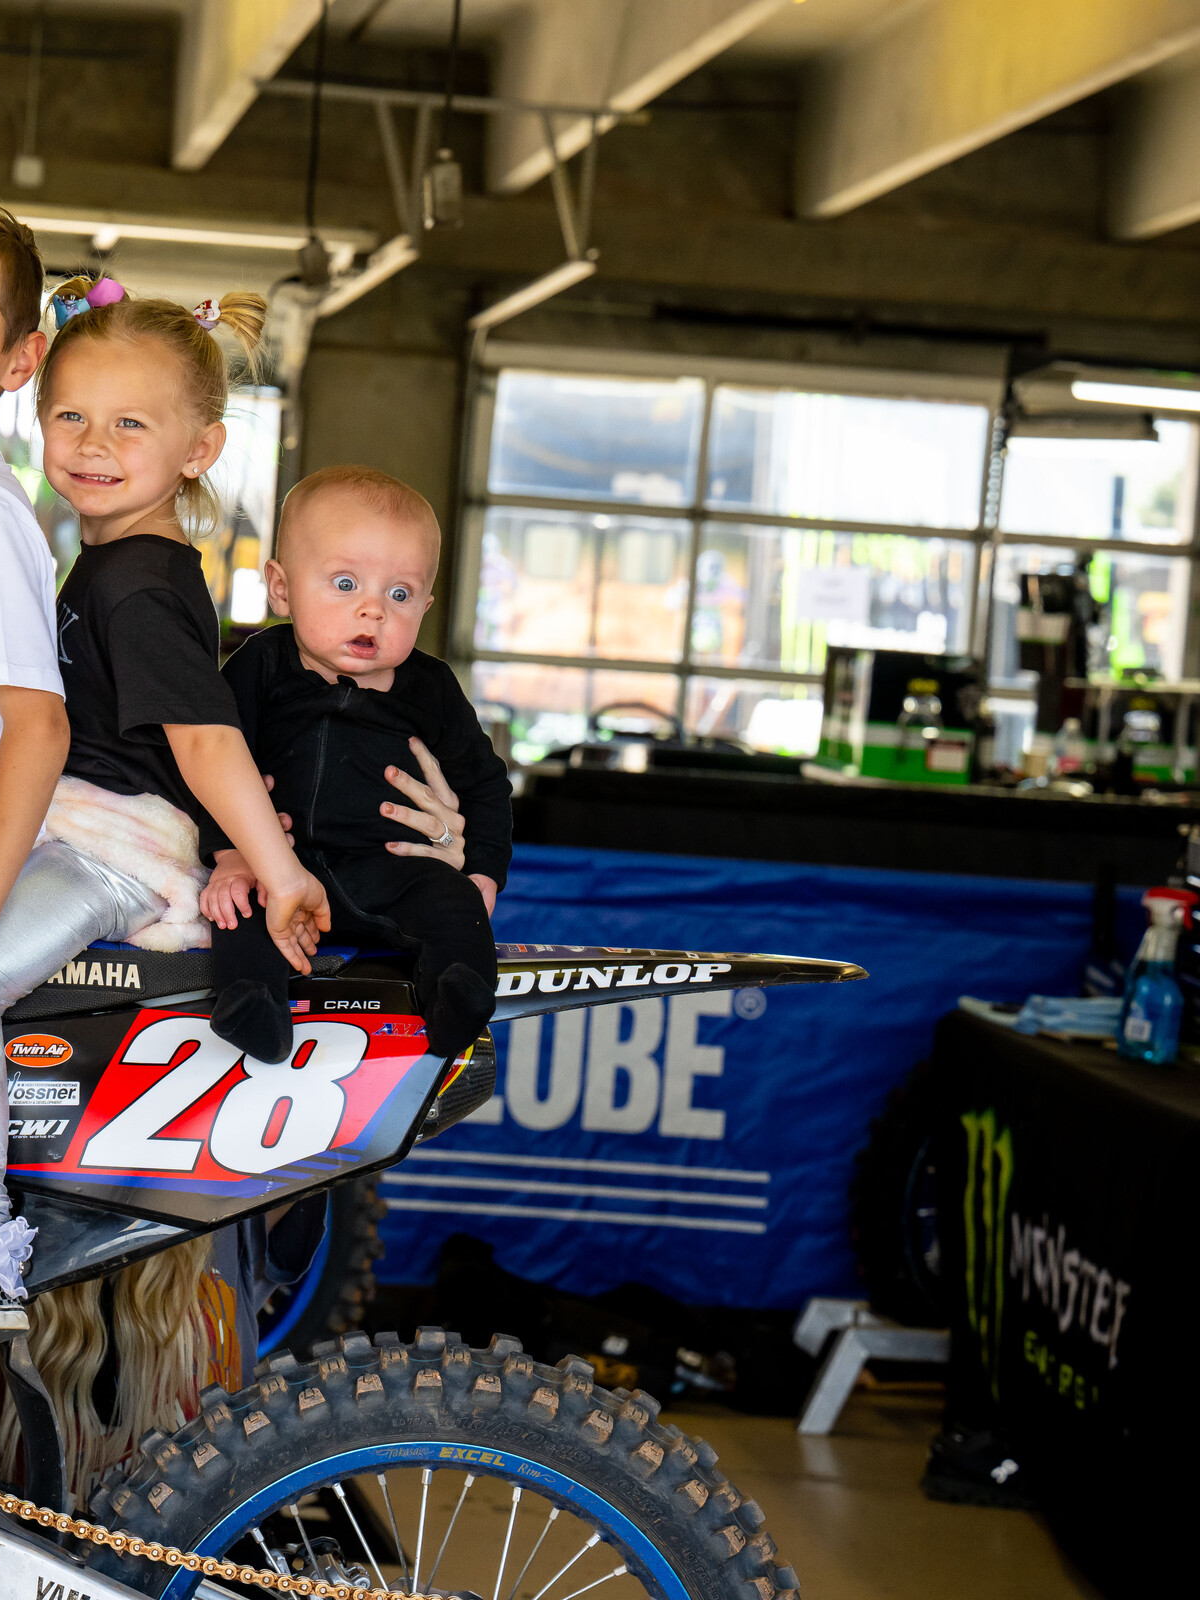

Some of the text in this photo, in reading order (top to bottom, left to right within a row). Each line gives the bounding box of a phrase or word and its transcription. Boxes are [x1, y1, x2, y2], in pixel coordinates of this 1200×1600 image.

[47, 961, 141, 989] AMAHA
[494, 963, 732, 997] DUNLOP
[323, 1000, 381, 1010] CRAIG
[12, 1043, 70, 1056] Twin Air
[77, 1016, 370, 1176] 28
[438, 1446, 506, 1467] EXCEL
[516, 1462, 542, 1478] Rim
